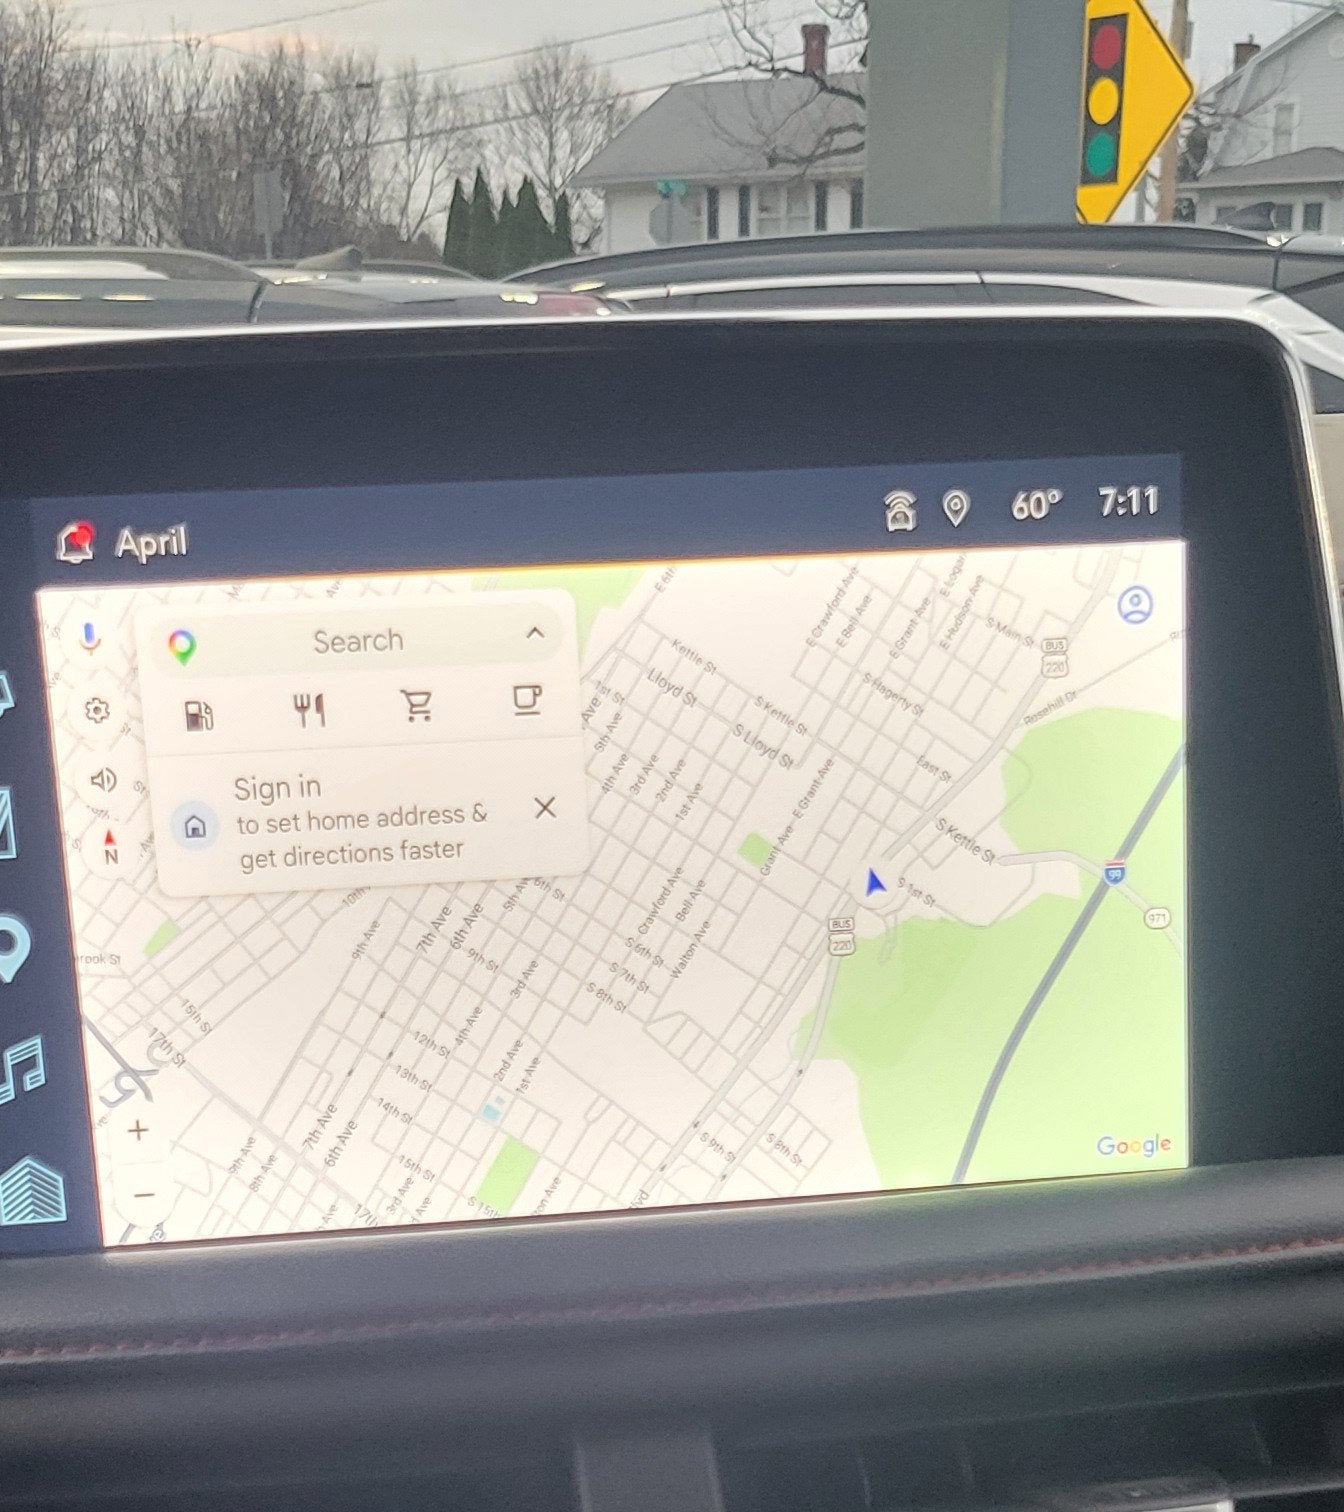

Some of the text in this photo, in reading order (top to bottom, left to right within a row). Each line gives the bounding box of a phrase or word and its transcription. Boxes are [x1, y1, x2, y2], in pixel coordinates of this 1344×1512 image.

[1011, 488, 1064, 520] 60°
[1098, 485, 1158, 516] 7:11
[115, 523, 189, 564] April
[967, 574, 985, 598] Ave
[811, 566, 859, 639] Crawford Ave
[855, 594, 873, 617] Ave
[894, 596, 931, 652] Grant Ave
[313, 628, 404, 654] Search
[1045, 640, 1064, 651] BUS
[671, 638, 717, 676] Kettle St
[648, 668, 698, 708] Lloyd St
[581, 697, 602, 723] Ave
[605, 711, 623, 734] Ave
[763, 702, 808, 736] Kettle St
[1023, 690, 1078, 726] Rosehill Dr
[732, 724, 794, 771] S Lloyd St
[612, 753, 629, 776] Ave
[630, 753, 660, 796] 3rd Ave
[655, 758, 687, 802] 2nd Ave
[916, 755, 952, 784] East St
[234, 773, 321, 806] Sign in
[799, 758, 834, 812] Grant Ave
[676, 782, 704, 821] 1st Ave
[237, 802, 488, 835] to set home address &
[105, 849, 119, 865] N
[240, 839, 465, 875] get directions faster
[760, 824, 794, 877] Grant Ave
[935, 818, 996, 865] S Kettle St
[1108, 869, 1122, 879] 99
[553, 888, 566, 901] St
[638, 866, 684, 935] Crawford Ave
[676, 878, 706, 922] Bell Ave
[364, 920, 380, 942] Ave
[416, 906, 452, 955] 7th Ave
[450, 902, 484, 951] 6th Ave
[1148, 913, 1166, 924] 971
[467, 947, 499, 973] 9th St
[634, 941, 665, 968] 6th St
[670, 919, 712, 979] Walton Ave
[510, 958, 539, 999] 3rd Ave
[618, 967, 650, 993] 7th St
[596, 987, 627, 1013] 8th St
[201, 1020, 213, 1035] St
[466, 1006, 483, 1029] Ave
[147, 1026, 186, 1069] 17th St
[412, 1030, 451, 1060] 12th St
[493, 1039, 524, 1082] 2nd Ave
[394, 1064, 433, 1093] 13th St
[525, 1056, 541, 1079] Ave
[302, 1103, 338, 1150] 7th Ave
[399, 1111, 413, 1124] St
[239, 1136, 256, 1158] Ave
[324, 1119, 358, 1167] 6th Ave
[709, 1138, 736, 1163] 9th St
[1097, 1133, 1171, 1157] Google
[260, 1153, 278, 1175] Ave
[790, 1152, 804, 1166] St
[422, 1168, 435, 1182] St
[386, 1176, 413, 1215] 3rd Ave
